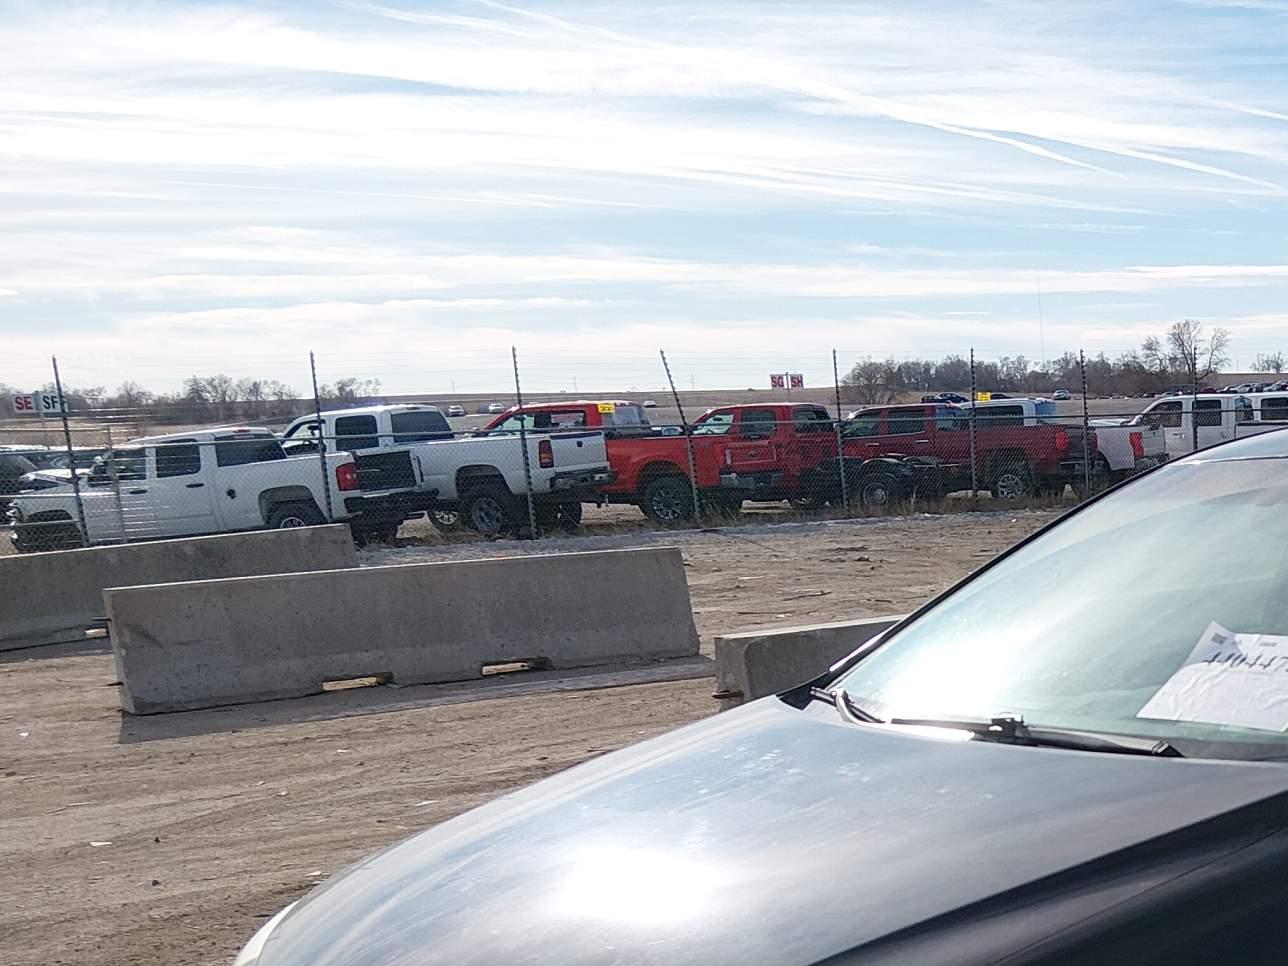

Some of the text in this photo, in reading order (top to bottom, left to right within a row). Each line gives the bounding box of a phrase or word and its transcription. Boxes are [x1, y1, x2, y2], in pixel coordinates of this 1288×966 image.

[771, 376, 784, 388] SG
[791, 376, 803, 388] SH
[15, 396, 33, 410] SE
